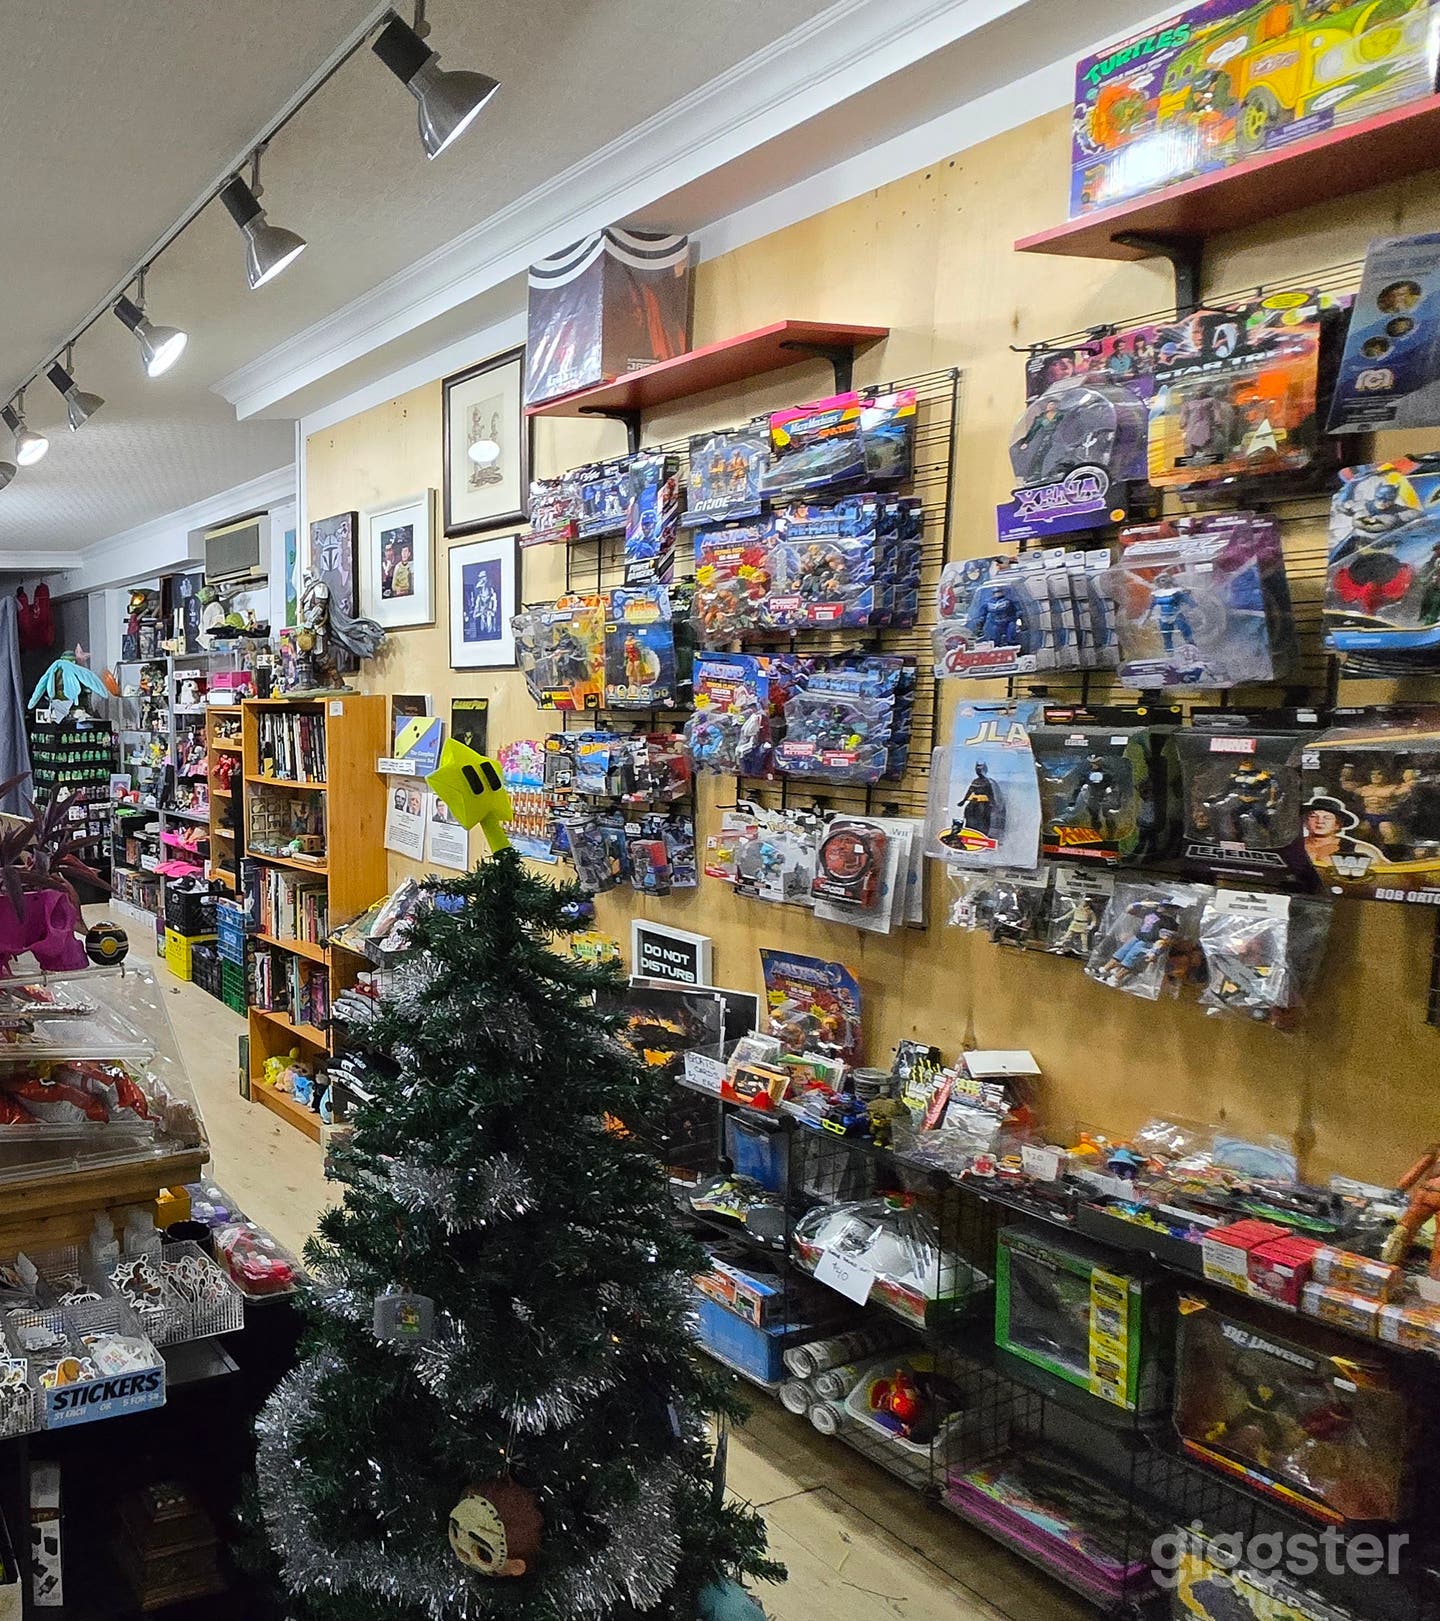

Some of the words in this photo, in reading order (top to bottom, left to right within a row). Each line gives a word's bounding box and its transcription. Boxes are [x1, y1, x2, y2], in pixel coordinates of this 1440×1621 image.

[1083, 23, 1192, 84] TURTLES
[1156, 361, 1222, 380] STAR
[1232, 346, 1303, 366] TREK
[1014, 477, 1101, 517] XENA
[965, 721, 1027, 745] JLA
[1376, 888, 1405, 901] BOB
[644, 943, 662, 957] DO
[663, 947, 690, 966] NOT
[640, 957, 695, 983] DISTURB
[53, 1371, 162, 1411] STICKERS
